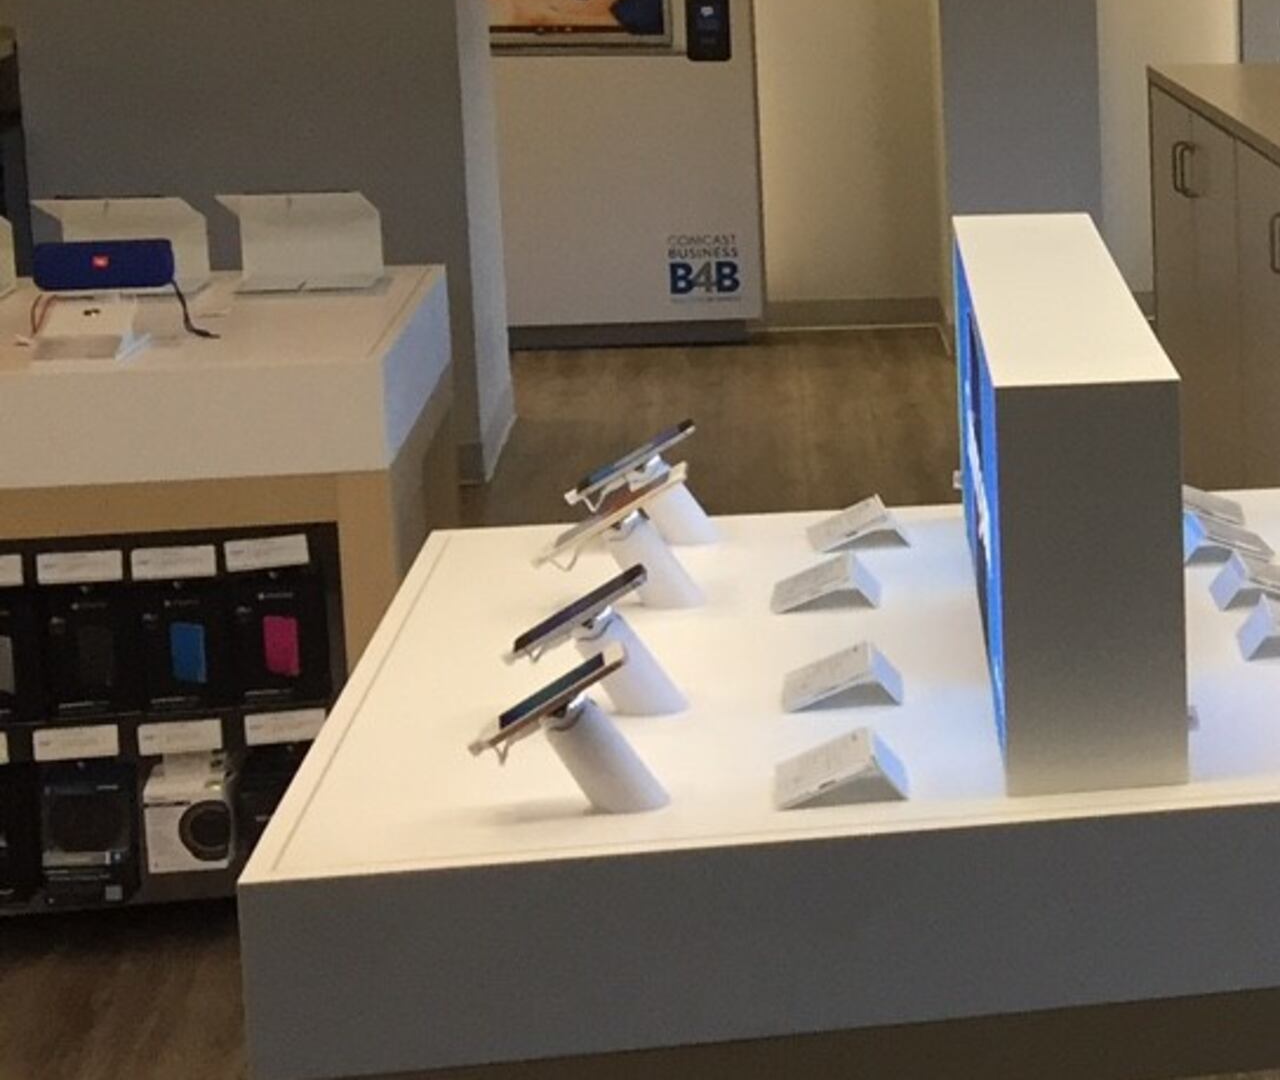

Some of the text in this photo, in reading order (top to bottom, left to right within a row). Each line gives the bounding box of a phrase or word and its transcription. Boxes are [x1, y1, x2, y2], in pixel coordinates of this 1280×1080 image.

[667, 233, 736, 246] COMCAST
[668, 247, 738, 259] BUSINESS
[670, 261, 741, 295] B4B
